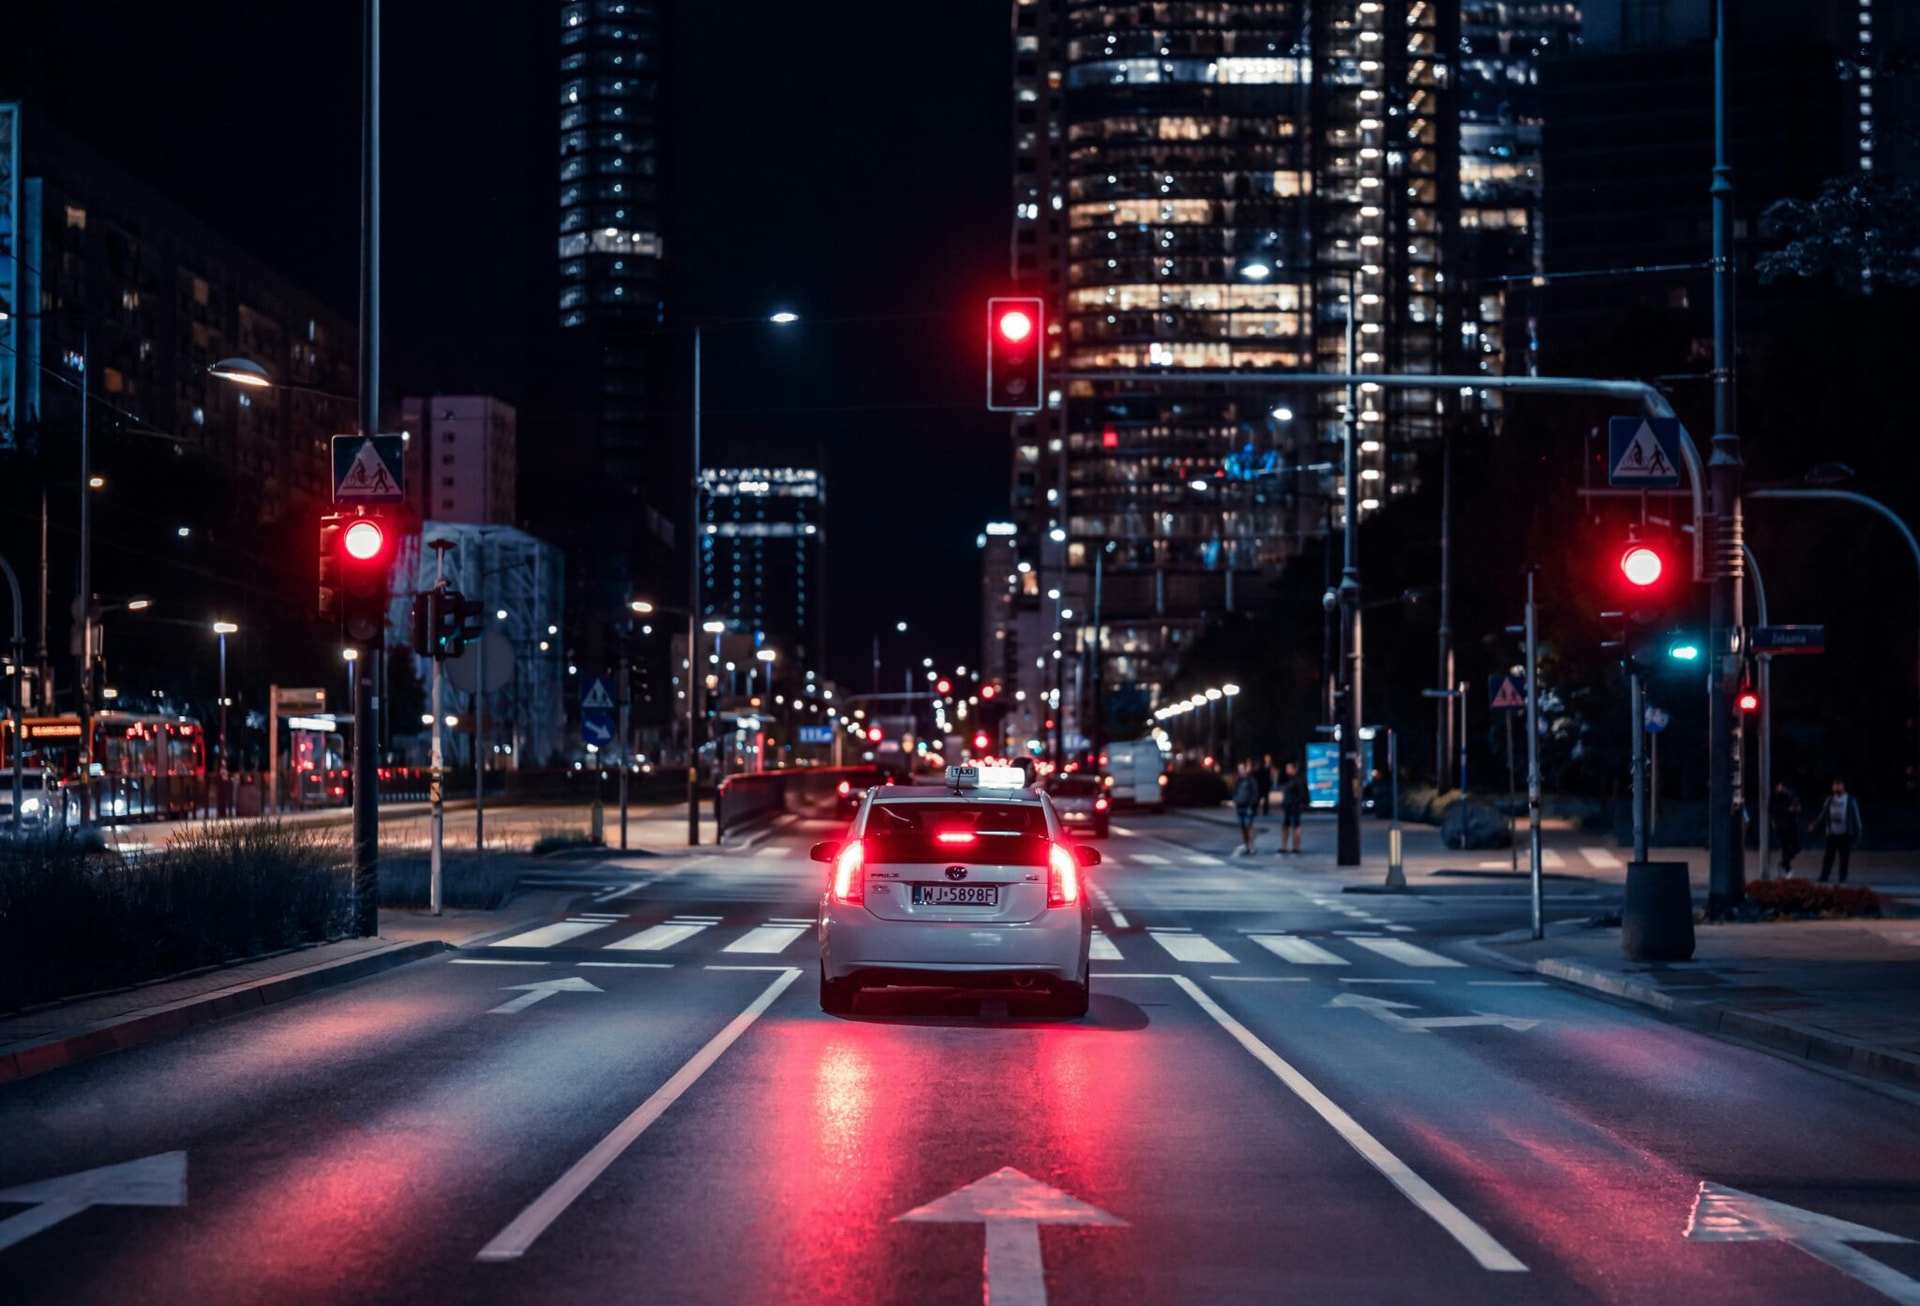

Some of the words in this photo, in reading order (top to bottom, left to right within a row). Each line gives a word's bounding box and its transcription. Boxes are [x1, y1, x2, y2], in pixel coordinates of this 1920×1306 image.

[954, 767, 973, 776] TAXI
[923, 887, 943, 902] WJ
[949, 887, 994, 902] 5898F
